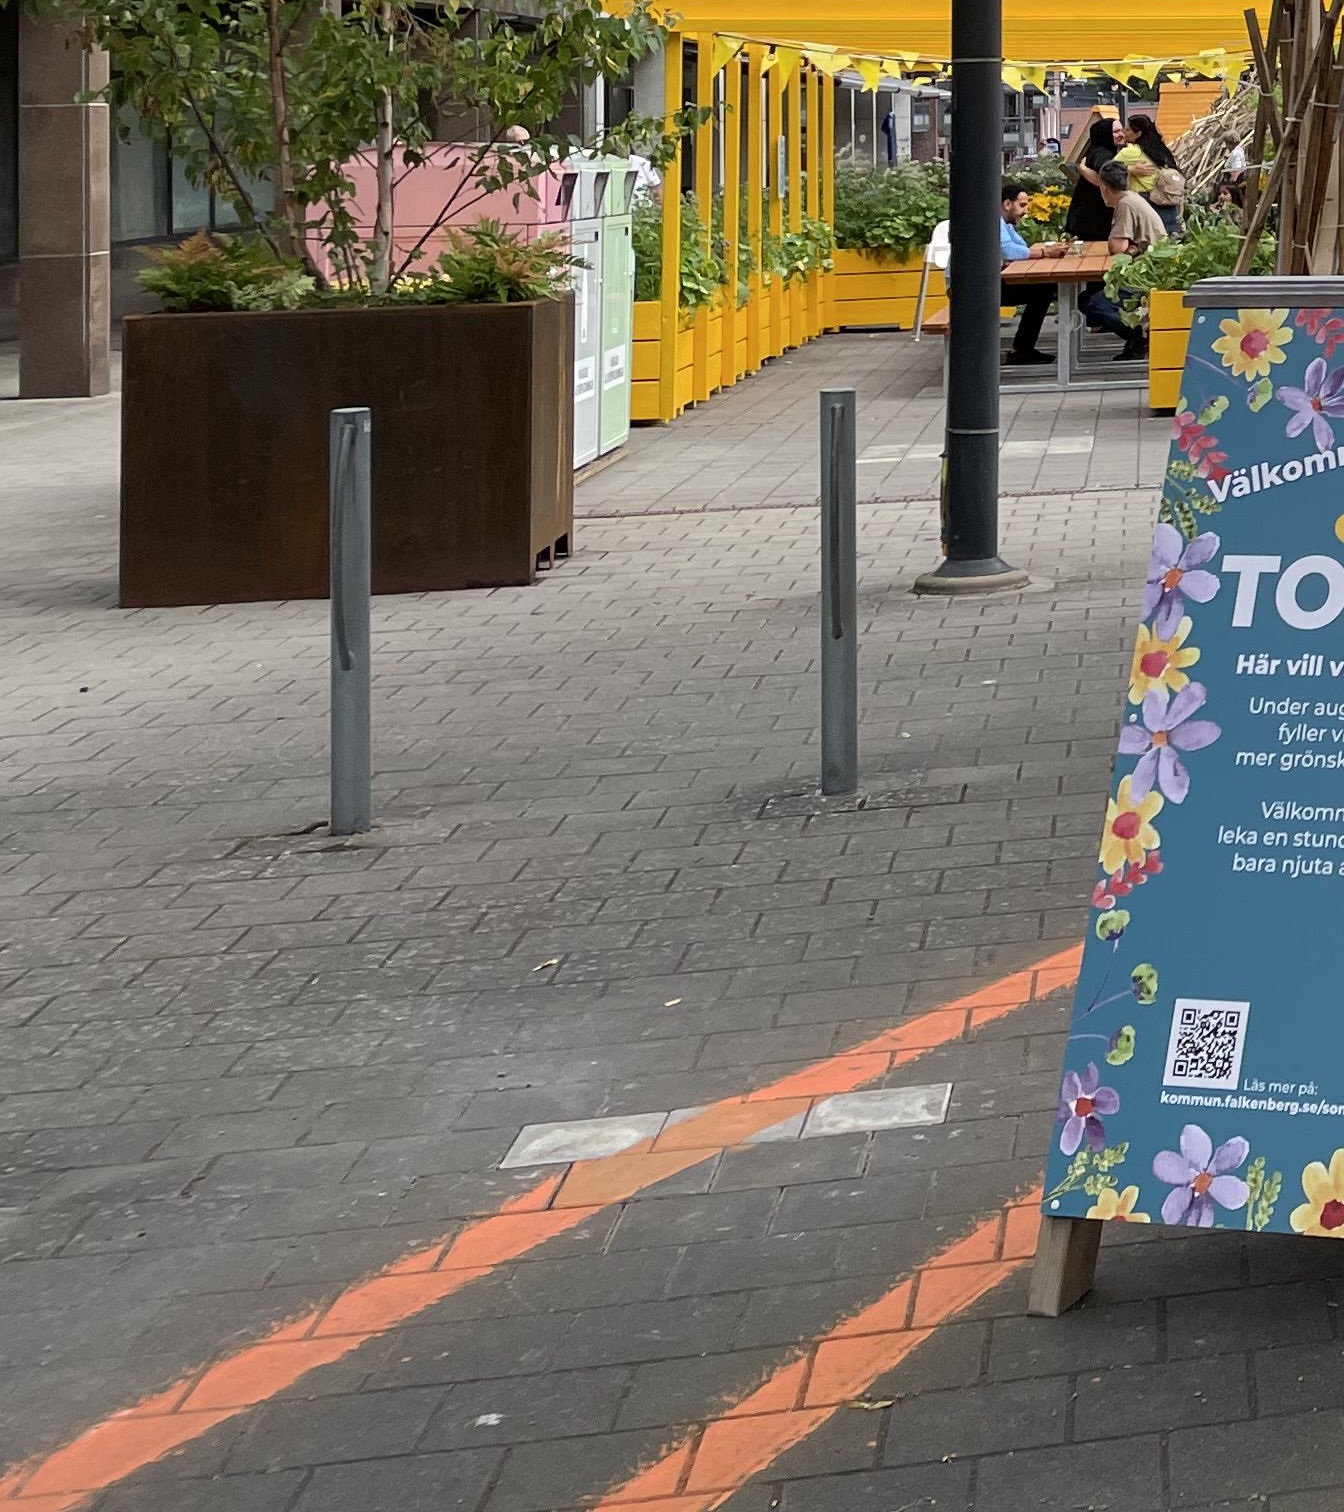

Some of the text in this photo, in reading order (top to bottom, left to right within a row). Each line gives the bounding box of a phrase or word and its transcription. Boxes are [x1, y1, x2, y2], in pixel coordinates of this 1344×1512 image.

[1236, 654, 1280, 676] Här
[1286, 655, 1324, 678] vill
[1249, 697, 1309, 718] Under
[1276, 723, 1326, 746] fyller
[1235, 751, 1277, 767] mer
[1217, 826, 1258, 845] leka
[1262, 831, 1288, 847] en
[1232, 854, 1276, 874] bara
[1281, 856, 1334, 879] njuta
[1243, 1079, 1319, 1097] Läs mer på:
